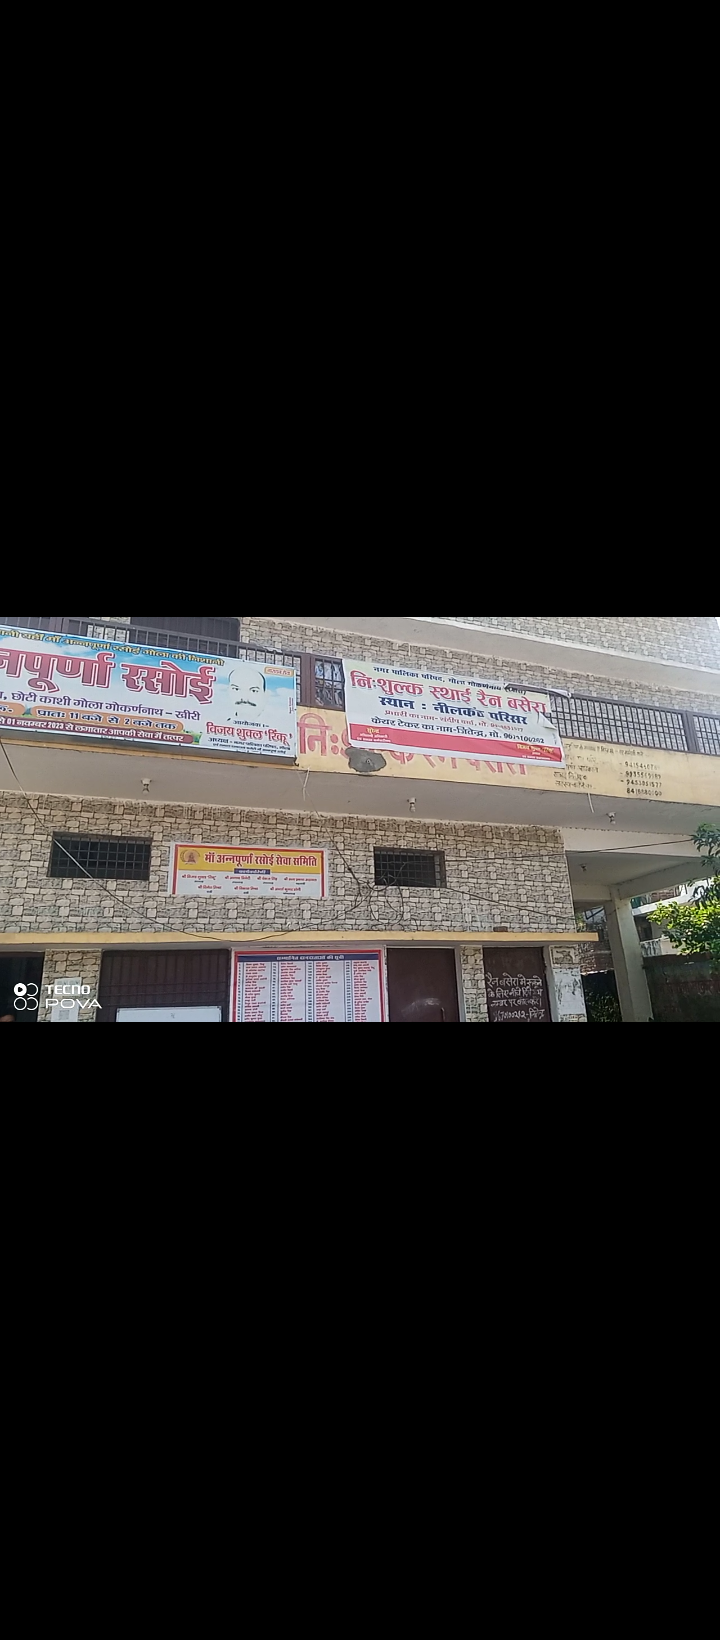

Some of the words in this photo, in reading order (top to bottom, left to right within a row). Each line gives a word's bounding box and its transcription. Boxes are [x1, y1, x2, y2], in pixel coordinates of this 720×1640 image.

[62, 638, 111, 650] अन्नपूर्णा
[113, 645, 140, 655] रसोई
[373, 666, 389, 674] नगर
[391, 668, 418, 679] पालिका
[121, 661, 216, 704] रसोई
[11, 691, 37, 703] छोटी
[40, 695, 71, 706] काशी
[73, 698, 103, 710] गोला
[105, 701, 162, 716] गोकर्णनाथ
[175, 710, 200, 721] खीरी
[429, 685, 471, 704] स्थाई
[476, 688, 502, 708] रैन
[507, 696, 546, 714] बसेरा
[378, 696, 414, 710] स्थान
[489, 710, 527, 725] परिसर
[82, 713, 102, 722] बजे
[108, 714, 119, 724] से
[133, 719, 152, 728] बजे
[155, 721, 177, 730] तक
[397, 718, 420, 730] टेकर
[421, 723, 434, 732] का
[48, 721, 63, 729] 2023
[65, 722, 74, 730] से
[75, 725, 107, 735] लगातार
[109, 728, 136, 737] आपकी
[137, 730, 153, 739] सेवा
[163, 734, 184, 742] तत्पर
[206, 721, 234, 737] विजय
[237, 727, 262, 741] शुक्ल
[216, 853, 252, 868] अन्नपूर्णा
[255, 854, 274, 866] रसोई
[276, 856, 291, 866] सेवा
[293, 855, 317, 867] समिति
[485, 972, 499, 988] रैन
[500, 972, 519, 987] बसेरा
